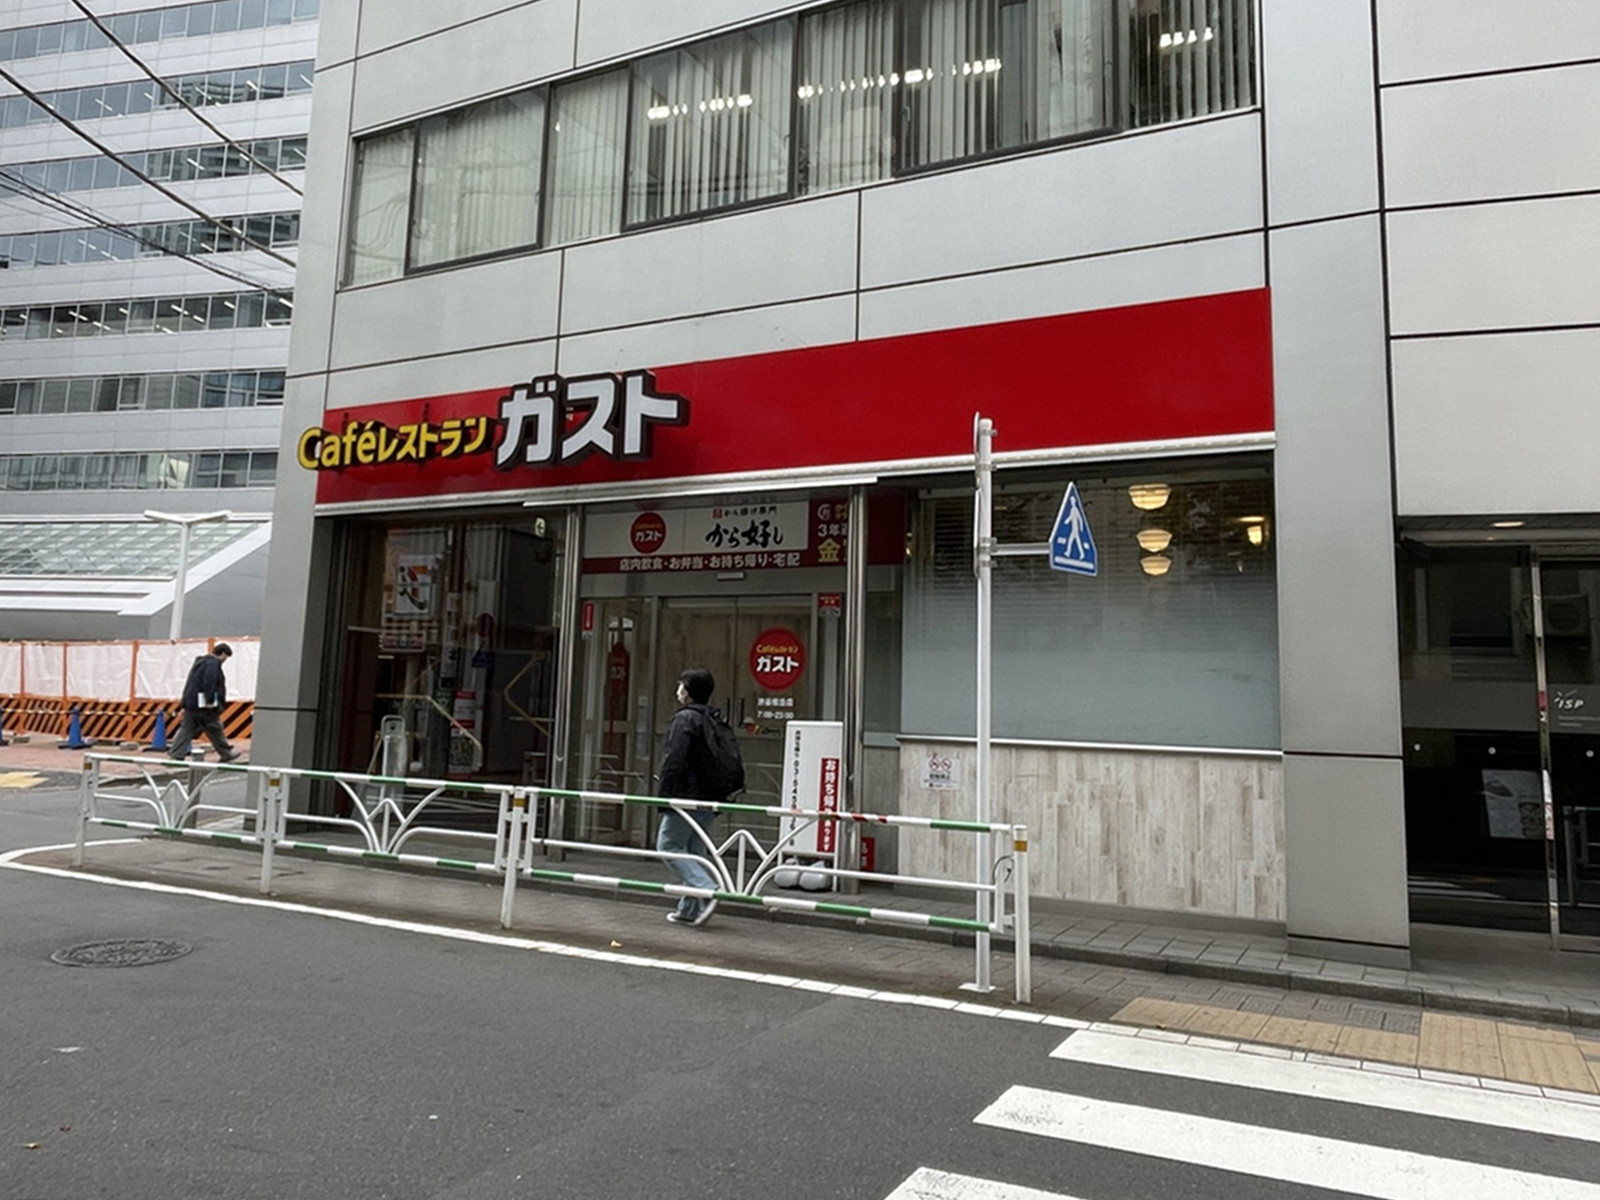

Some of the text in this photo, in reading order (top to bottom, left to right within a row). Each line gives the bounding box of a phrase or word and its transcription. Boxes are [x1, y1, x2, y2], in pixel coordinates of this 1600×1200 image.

[297, 373, 682, 470] Caféレストラン ガスト
[634, 529, 664, 543] ガスト
[705, 519, 784, 549] から好し
[755, 655, 800, 674] ガスト
